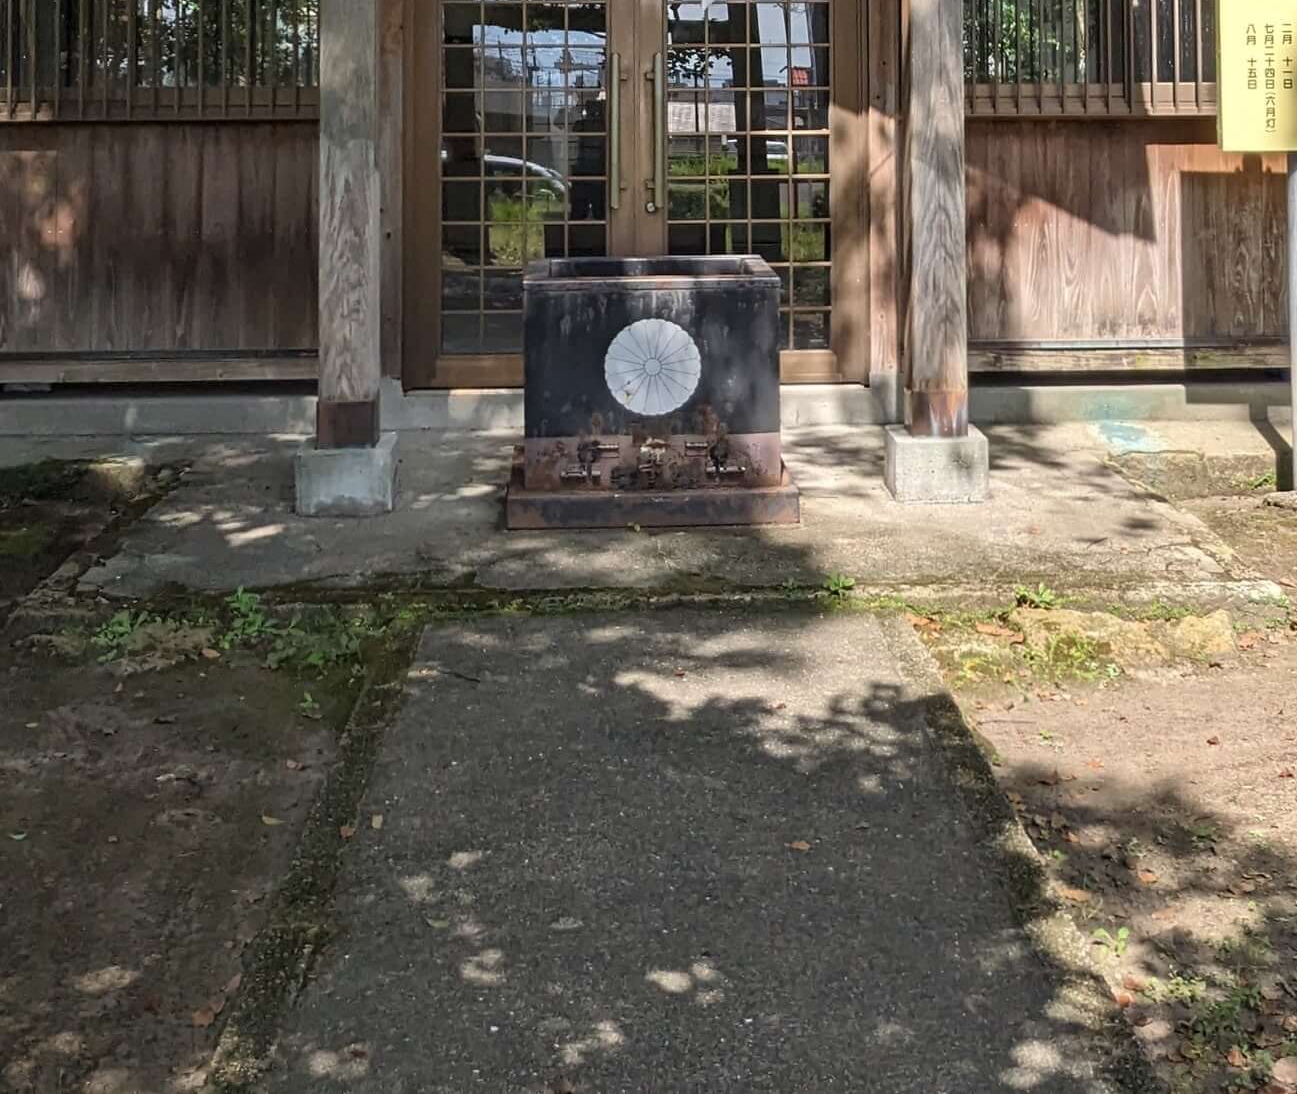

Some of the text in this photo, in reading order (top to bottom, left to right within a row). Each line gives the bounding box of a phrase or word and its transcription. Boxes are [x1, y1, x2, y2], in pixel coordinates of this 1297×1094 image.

[1246, 24, 1257, 46] 八月
[1281, 23, 1293, 45] 二月
[1247, 57, 1257, 90] 十五日
[1282, 56, 1294, 89] 十一日
